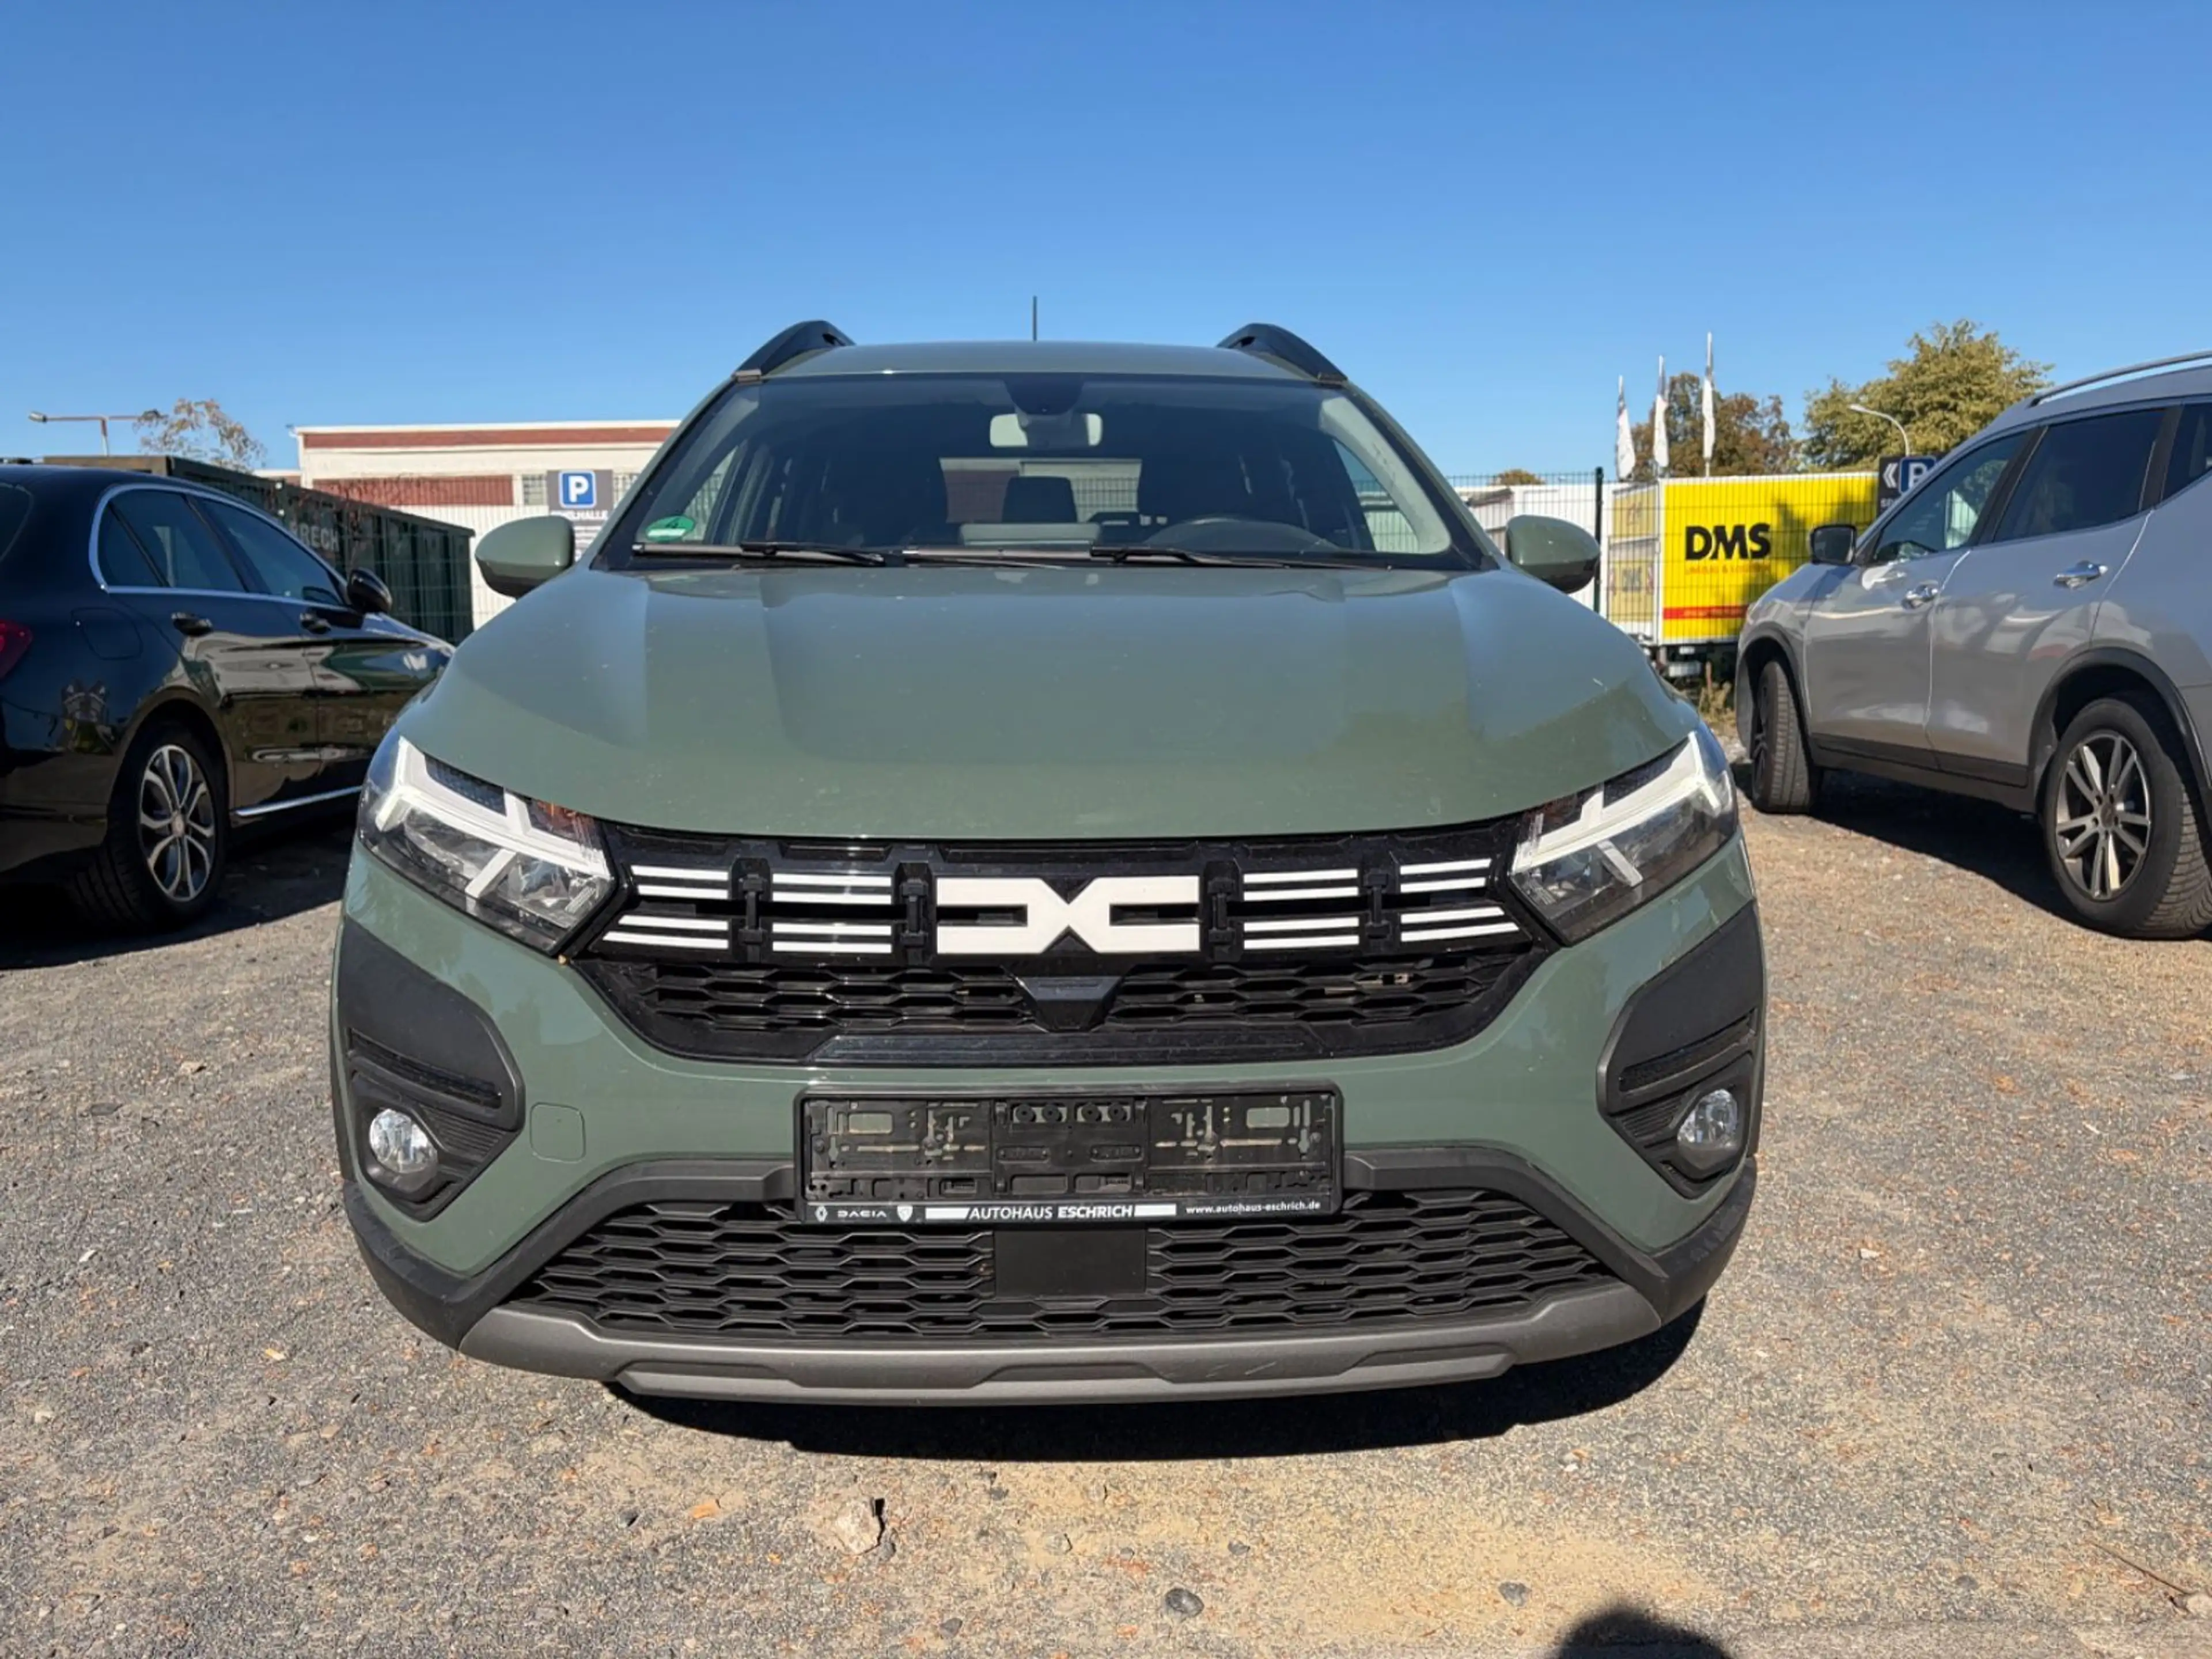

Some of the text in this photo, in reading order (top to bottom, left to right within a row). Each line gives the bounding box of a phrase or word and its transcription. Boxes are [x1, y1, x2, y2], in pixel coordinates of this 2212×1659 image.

[568, 475, 589, 502] P
[1685, 522, 1771, 560] DMS
[838, 1199, 1321, 1220] DACIA AUTOHAUS ESCHRICH www.autohaus-eschrich.de
